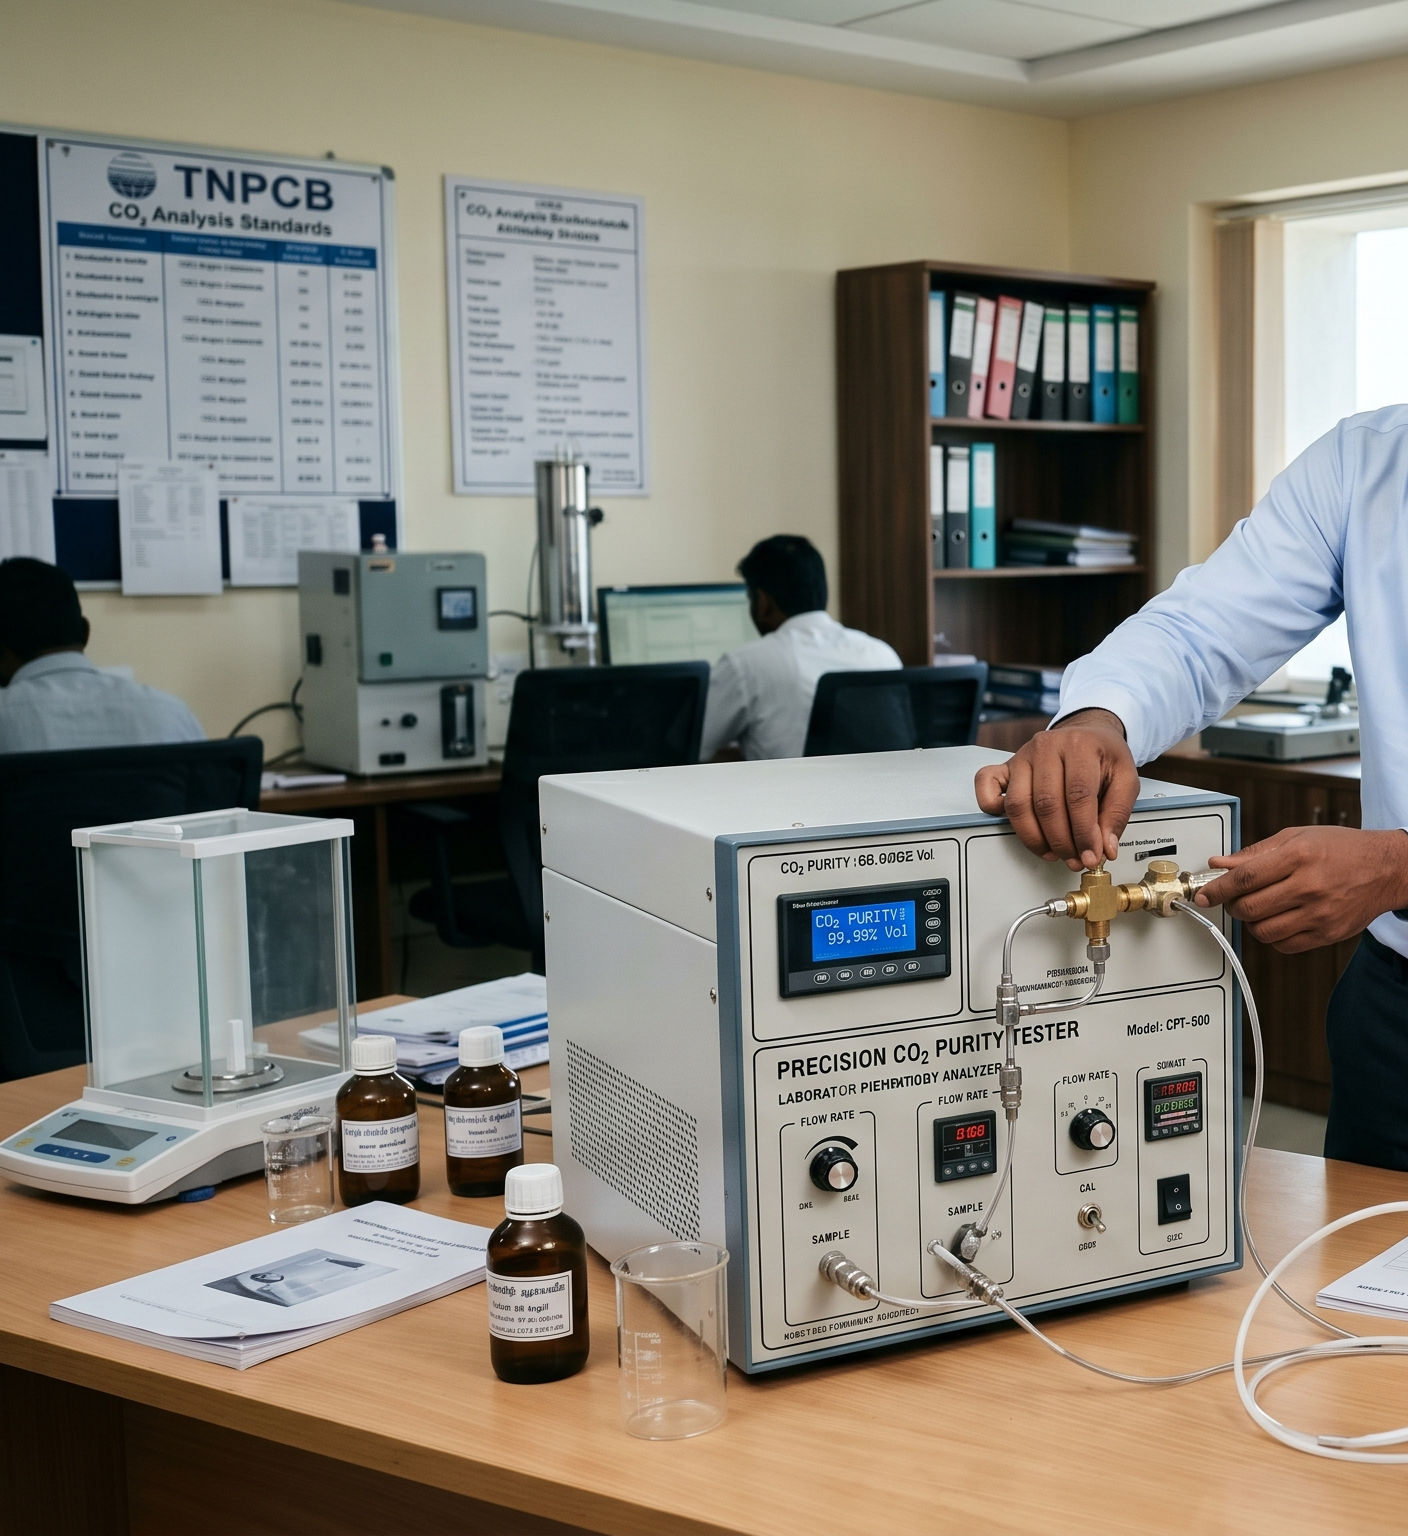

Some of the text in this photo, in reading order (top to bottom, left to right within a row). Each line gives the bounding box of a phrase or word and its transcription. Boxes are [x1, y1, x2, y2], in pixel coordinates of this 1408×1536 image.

[174, 163, 334, 212] TNPCB
[108, 201, 333, 237] CO₂ Analysis Standards
[780, 861, 804, 875] CO₂
[807, 857, 850, 871] PURITY
[916, 848, 935, 861] Vol.
[815, 914, 839, 929] CO₂
[828, 924, 908, 946] 99.99% Vol
[1127, 1014, 1210, 1036] Model: CPT-500
[777, 1020, 1080, 1080] PRECISION CO₂ PURITY TESTER
[778, 1084, 856, 1106] LABORATOR
[942, 1062, 1002, 1082] ANALYZER
[1062, 1069, 1110, 1085] FLOW RATE
[938, 1089, 988, 1106] FLOW RATE
[800, 1110, 855, 1127] FLOW RATE
[1079, 1182, 1096, 1193] CAL
[948, 1202, 983, 1217] SAMPLE
[812, 1229, 850, 1244] SAMPLE
